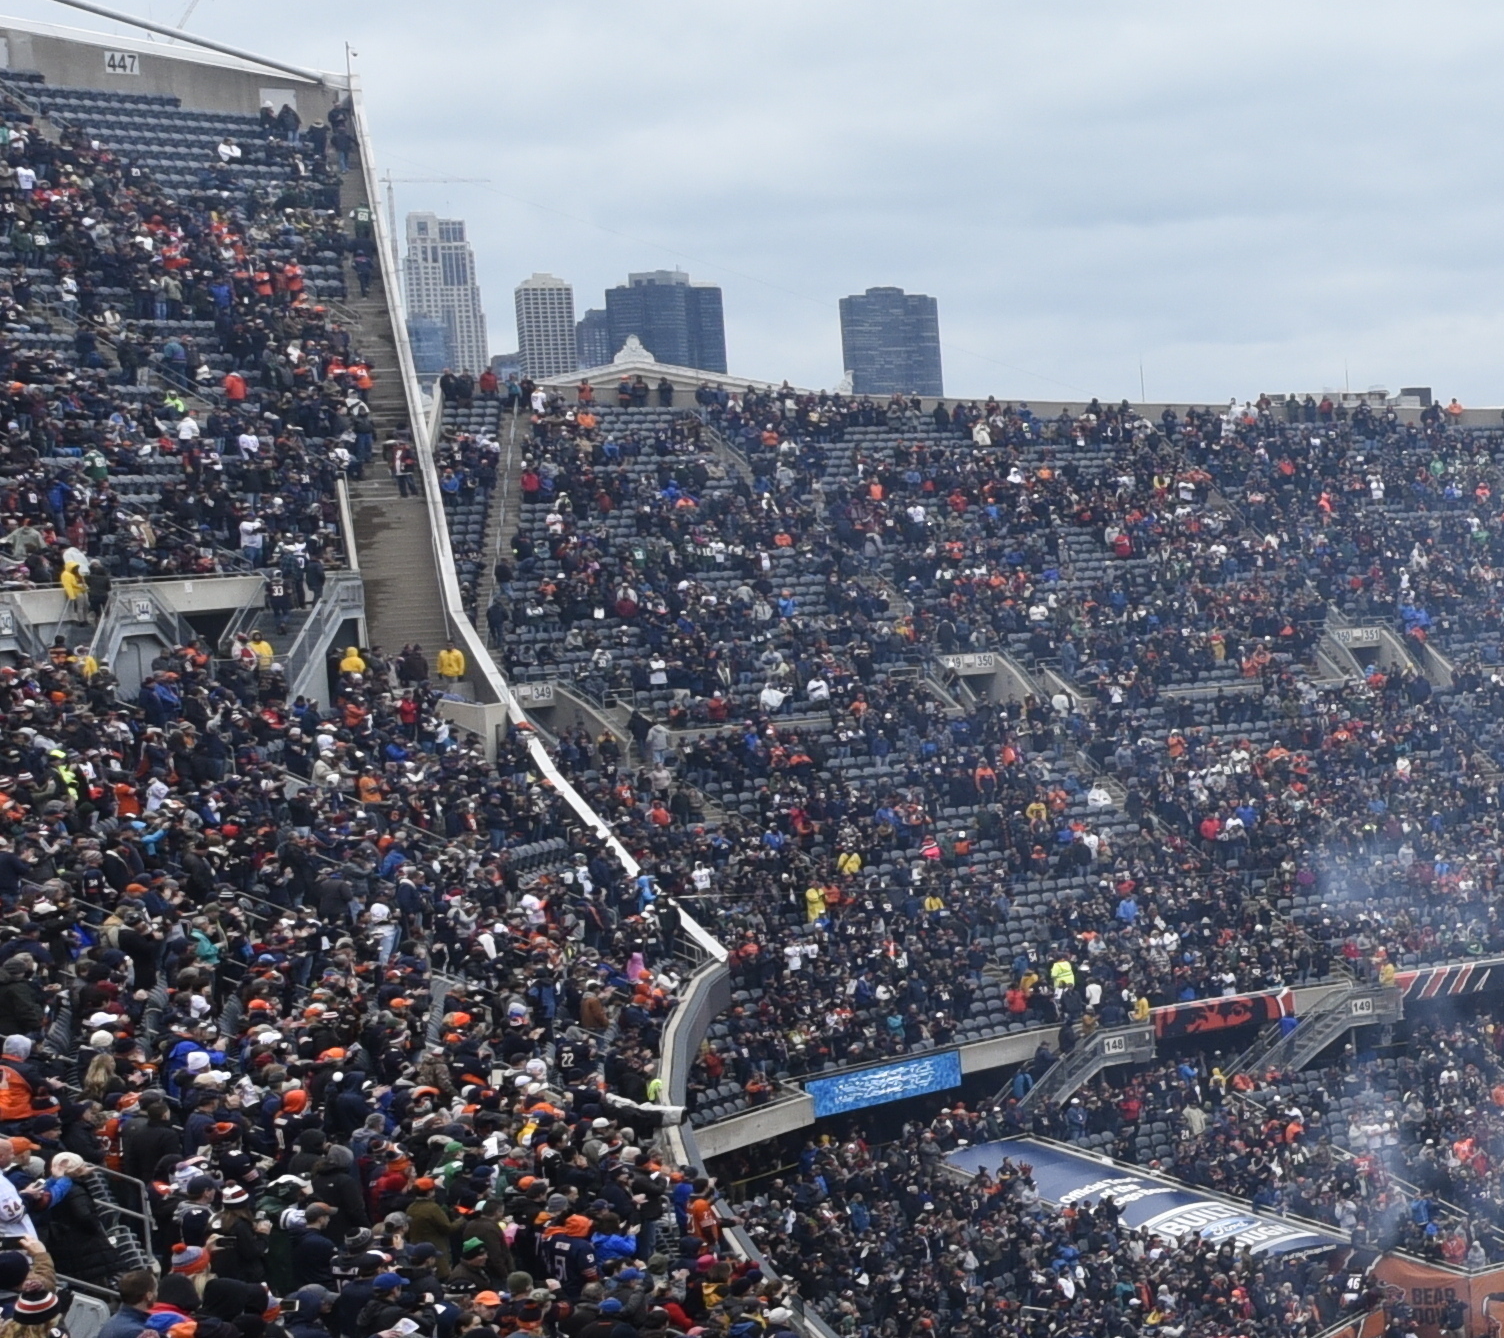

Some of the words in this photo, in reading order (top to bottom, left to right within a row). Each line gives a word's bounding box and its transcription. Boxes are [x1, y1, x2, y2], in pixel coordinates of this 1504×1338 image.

[106, 52, 137, 73] 447
[533, 684, 552, 700] 349
[1352, 999, 1371, 1013] 149
[1104, 1038, 1124, 1053] 148
[561, 1053, 575, 1068] 22
